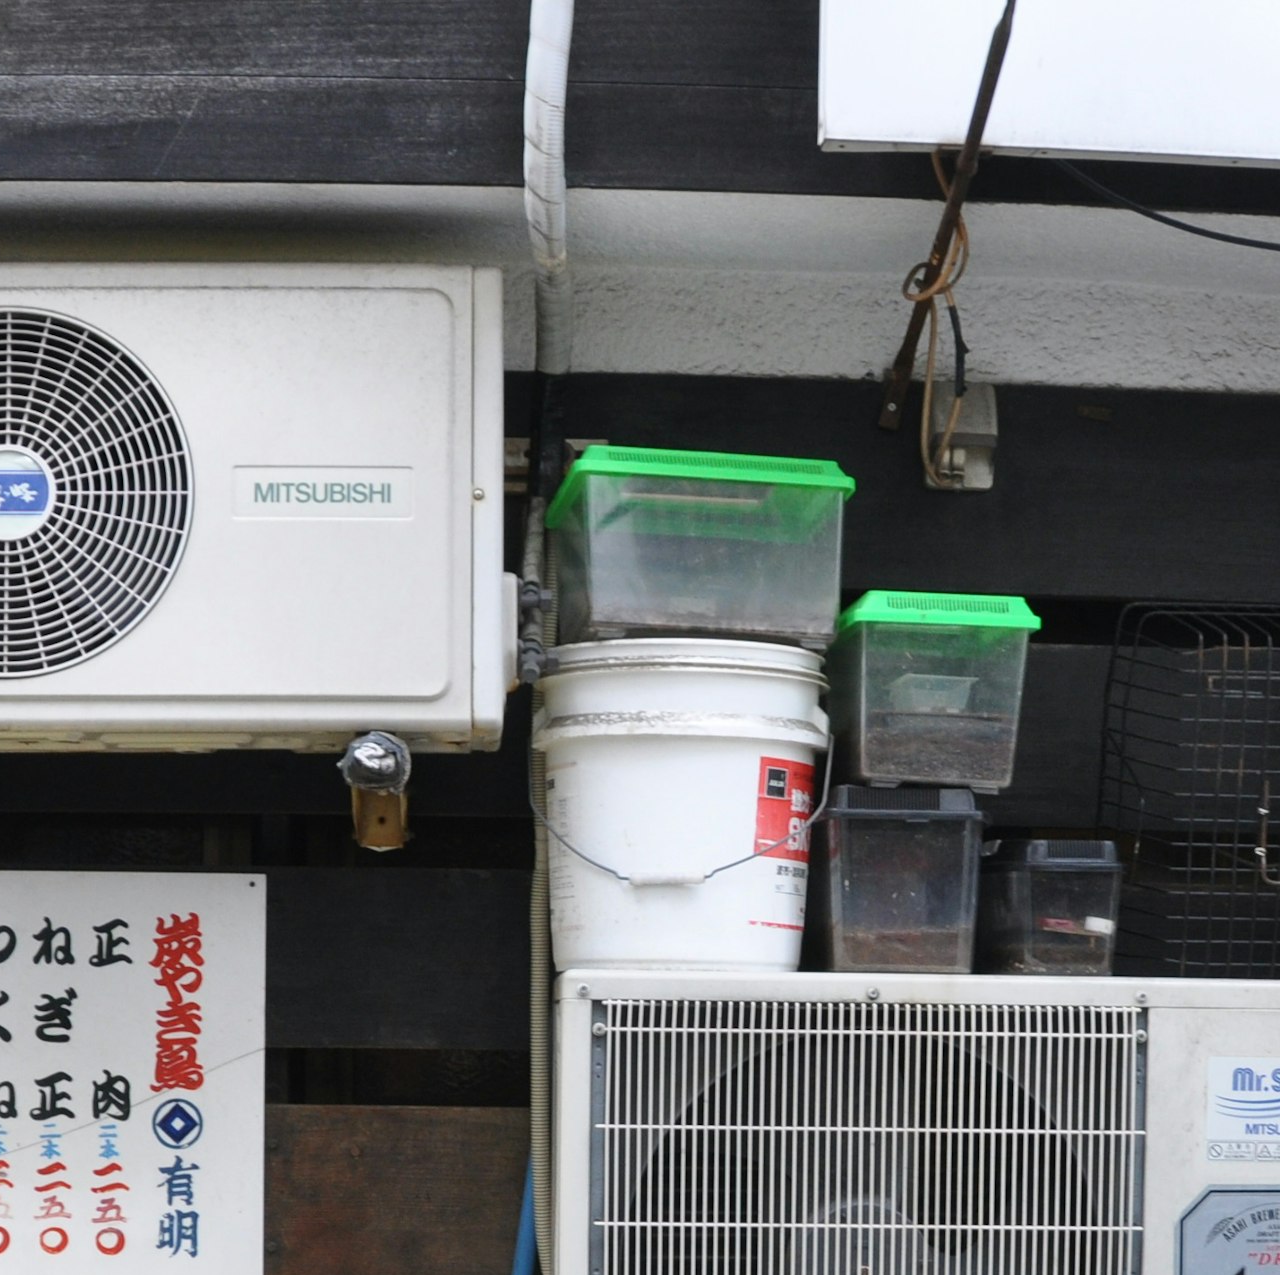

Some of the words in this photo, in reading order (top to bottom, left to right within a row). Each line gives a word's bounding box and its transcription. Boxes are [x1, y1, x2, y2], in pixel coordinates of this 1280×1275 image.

[254, 482, 391, 504] MITSUBISHI
[156, 1155, 201, 1258] 有明
[1222, 1217, 1248, 1242] ASAHI
